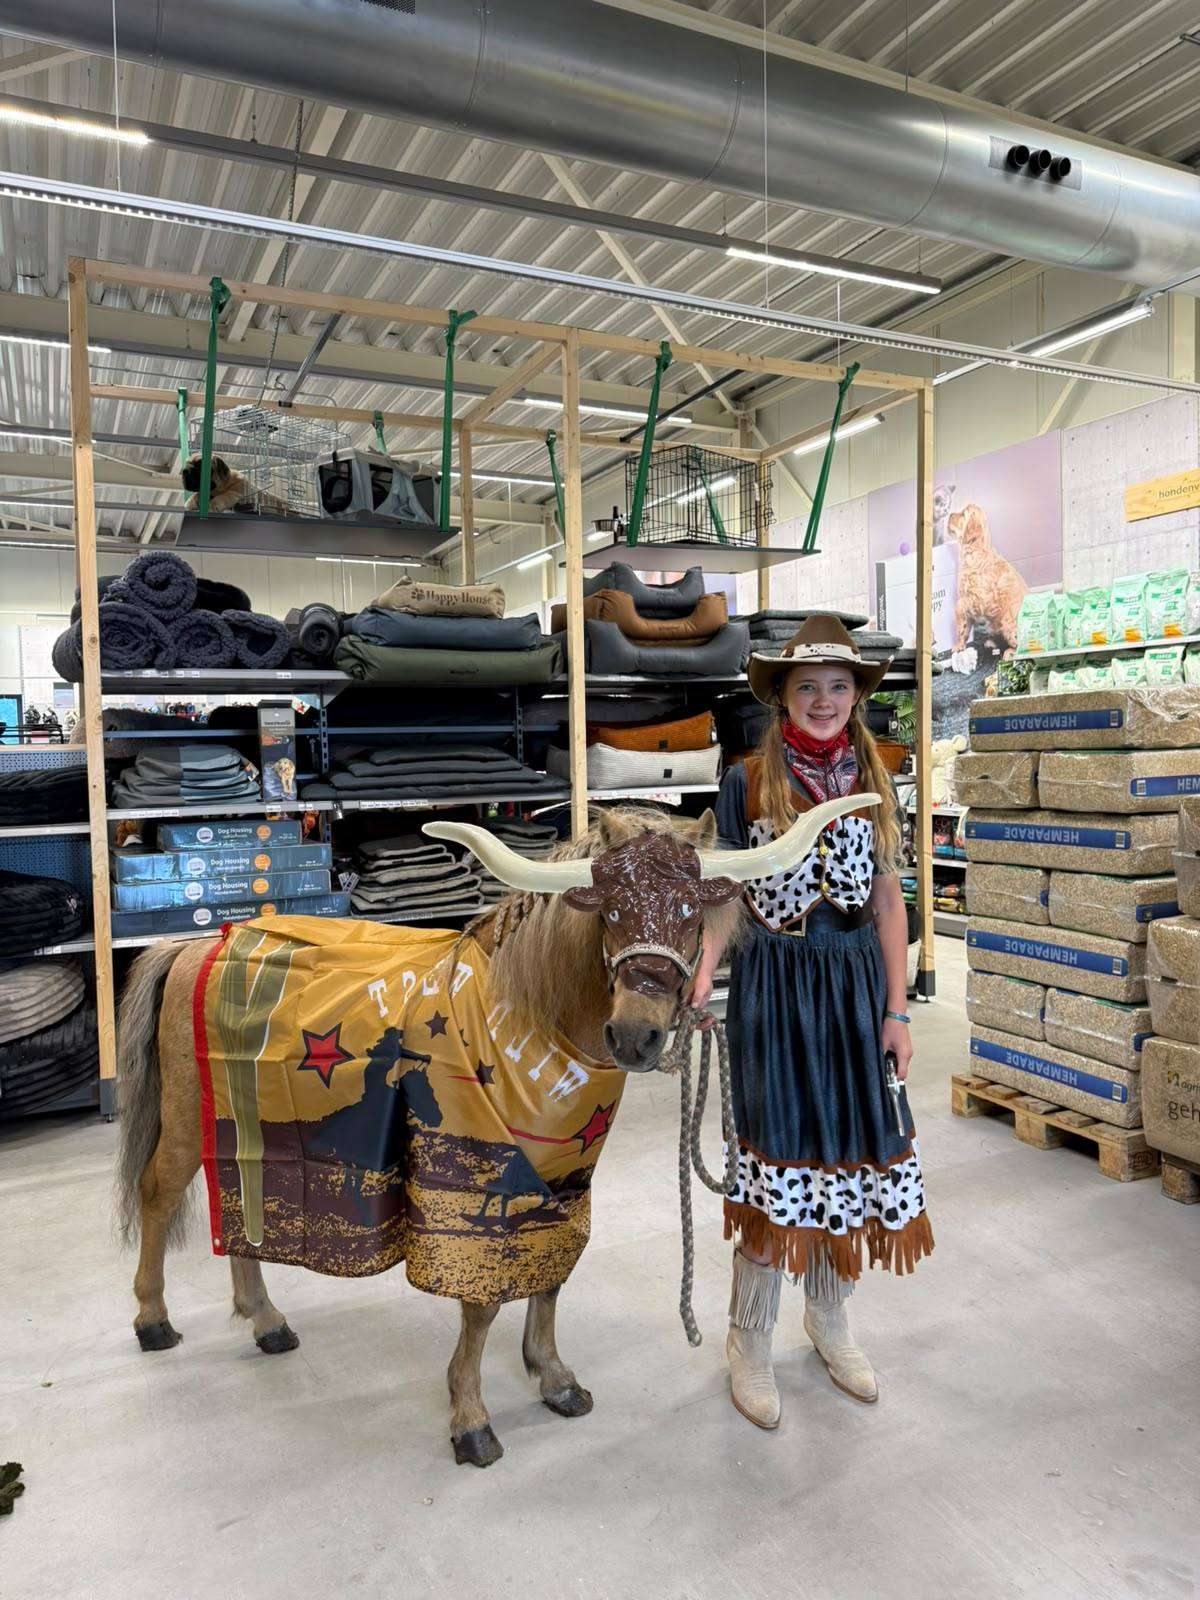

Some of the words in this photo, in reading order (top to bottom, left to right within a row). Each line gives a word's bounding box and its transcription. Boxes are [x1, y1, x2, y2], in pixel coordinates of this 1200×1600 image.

[426, 590, 459, 606] Happy
[1004, 714, 1077, 731] HEMPARADE
[1004, 826, 1080, 844] HEMPARADE
[210, 859, 223, 867] Dog
[224, 858, 250, 866] Housing
[208, 883, 222, 891] Dog
[222, 882, 248, 891] Housing
[230, 906, 256, 915] Housing
[1005, 939, 1078, 965] HEMPARADE
[1006, 1052, 1078, 1086] HEMPARADE
